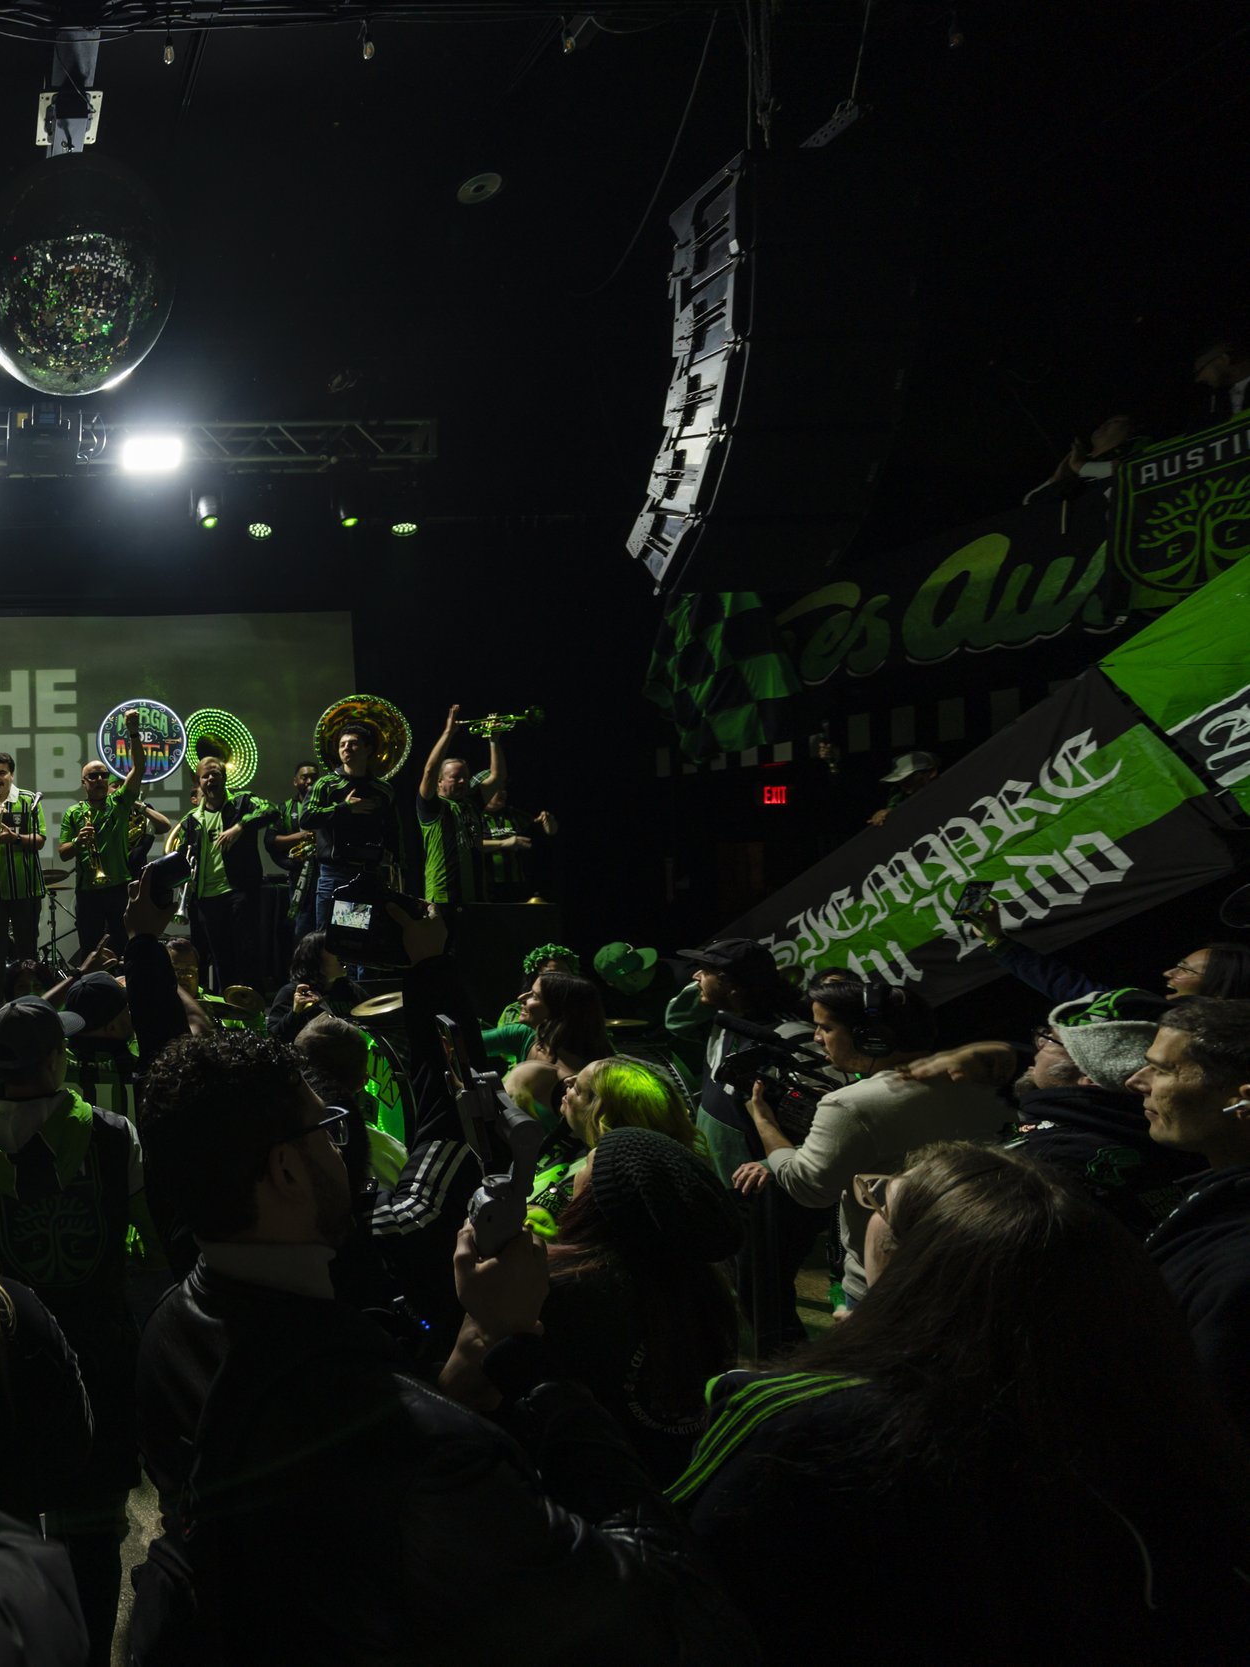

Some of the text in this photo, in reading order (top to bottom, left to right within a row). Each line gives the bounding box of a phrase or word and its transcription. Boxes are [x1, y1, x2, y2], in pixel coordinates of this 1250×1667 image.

[116, 707, 169, 736] MRGA
[115, 739, 169, 775] ATIN
[763, 786, 787, 805] EXIT
